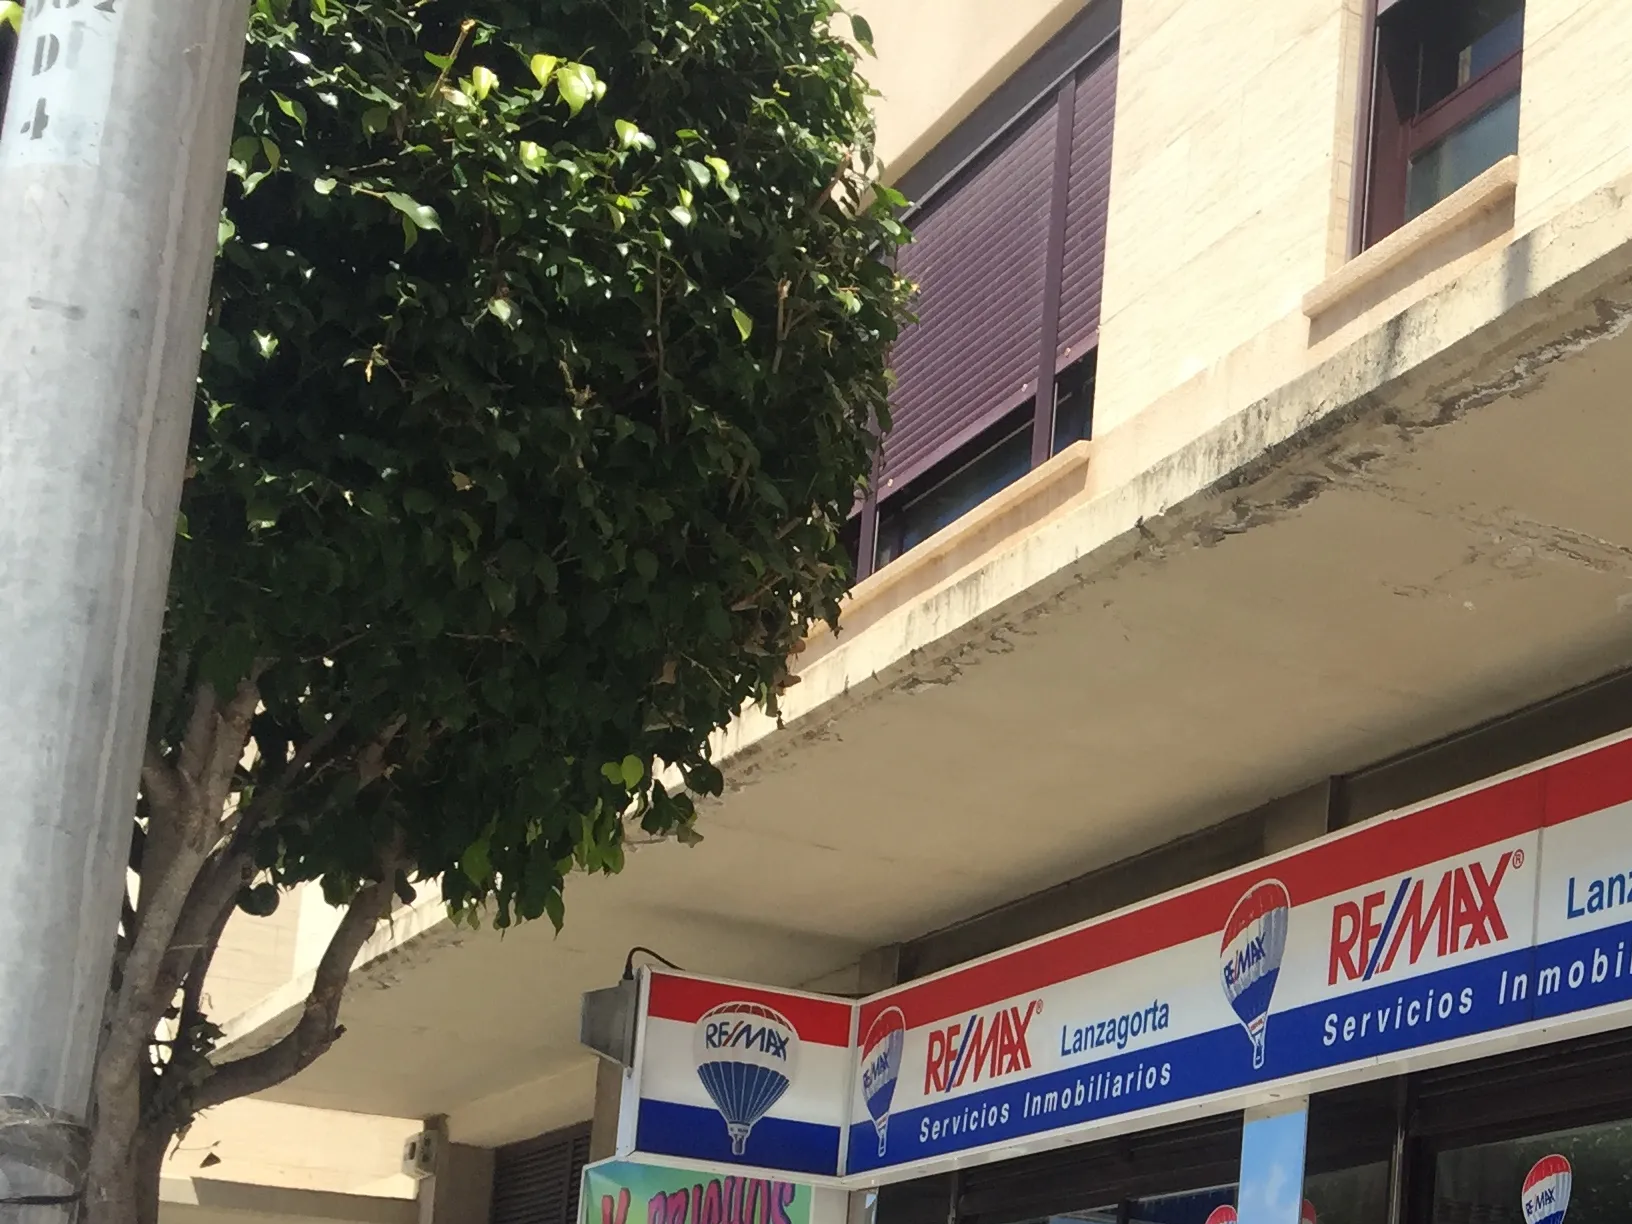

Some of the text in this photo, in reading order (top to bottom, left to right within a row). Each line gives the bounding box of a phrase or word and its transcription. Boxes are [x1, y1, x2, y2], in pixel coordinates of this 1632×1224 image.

[705, 1020, 789, 1061] RE/MAX
[1060, 999, 1169, 1057] Lanzagorta
[1323, 984, 1473, 1046] Servicios
[920, 1062, 1172, 1143] Servicios Inmobiliarios
